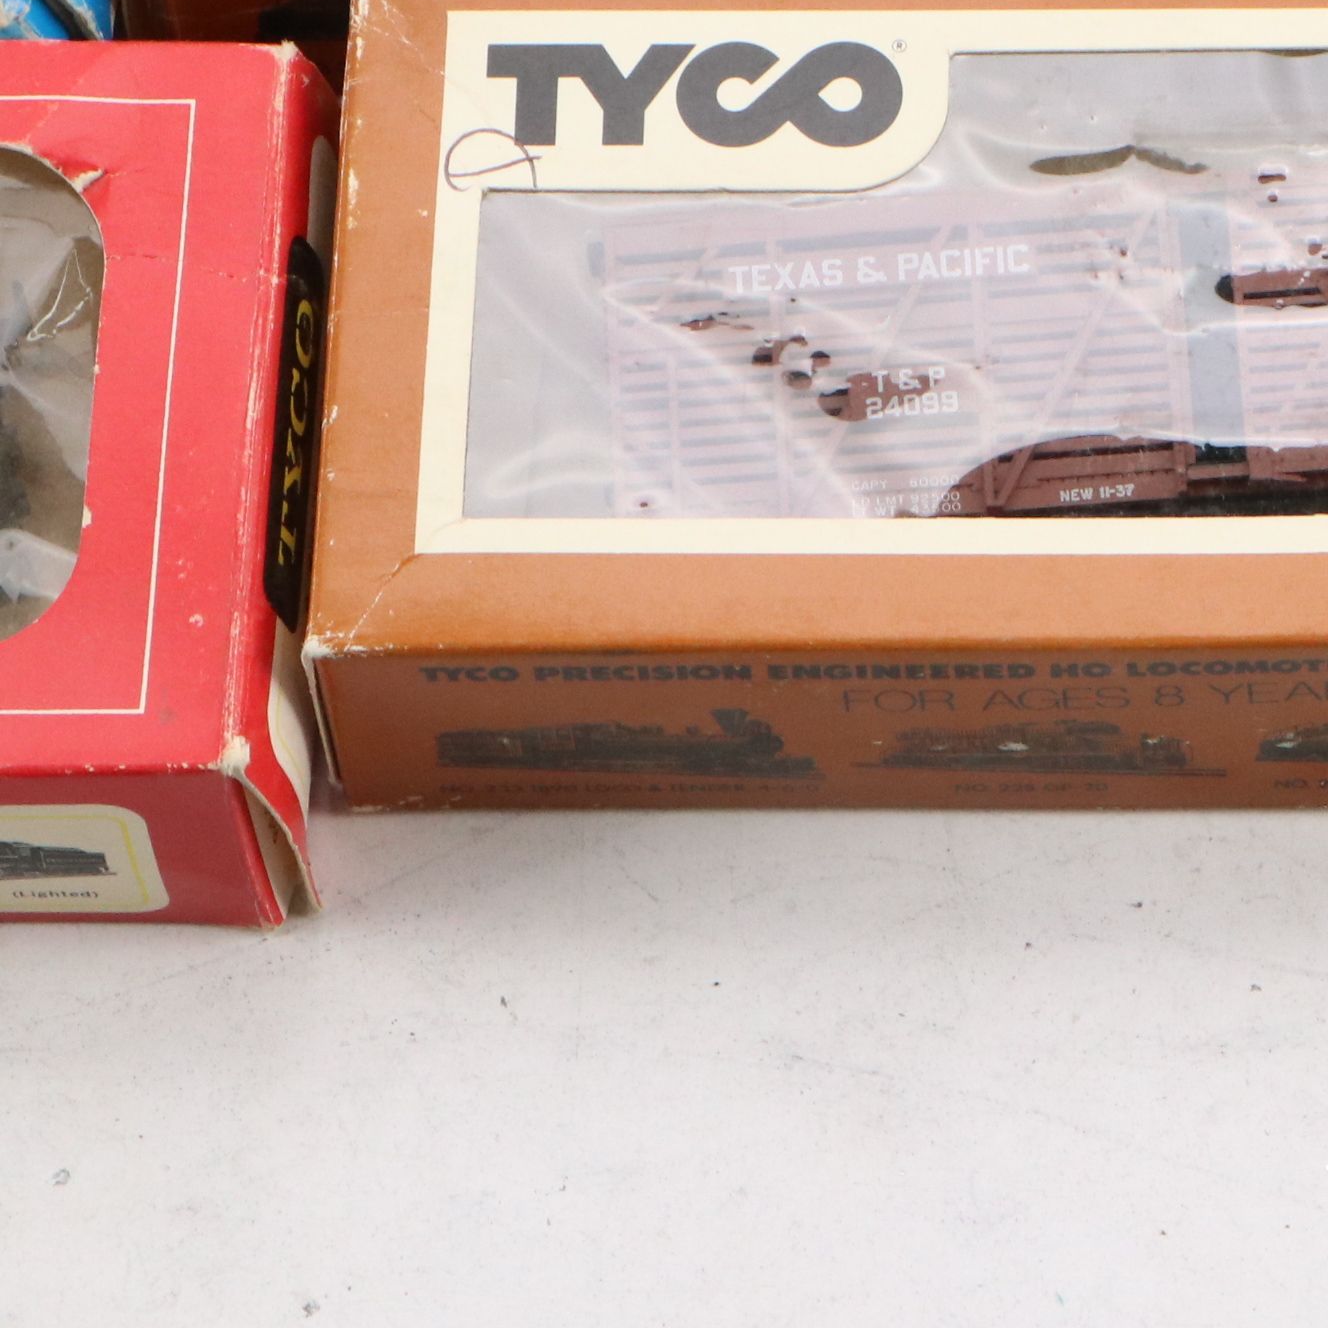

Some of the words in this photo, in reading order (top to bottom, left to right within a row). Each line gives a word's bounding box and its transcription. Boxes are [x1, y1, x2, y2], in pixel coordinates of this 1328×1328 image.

[486, 41, 904, 148] TYCO
[727, 258, 844, 294] TEXAS
[856, 256, 888, 284] &
[897, 244, 1032, 281] PACIFIC
[870, 370, 888, 394] T
[897, 368, 922, 391] &
[928, 366, 946, 390] P
[865, 390, 959, 420] 24099
[277, 299, 314, 566] TYCO
[1059, 488, 1094, 503] NEW
[1099, 483, 1135, 499] 11-37
[418, 665, 519, 682] TYCO
[533, 663, 752, 682] PRECISION
[767, 661, 1036, 681] ENGINEERED
[1049, 662, 1102, 679] HO
[842, 688, 957, 712] FOR
[981, 684, 1130, 711] AGES
[1154, 684, 1185, 708] 8
[12, 889, 99, 900] (Lighted)
